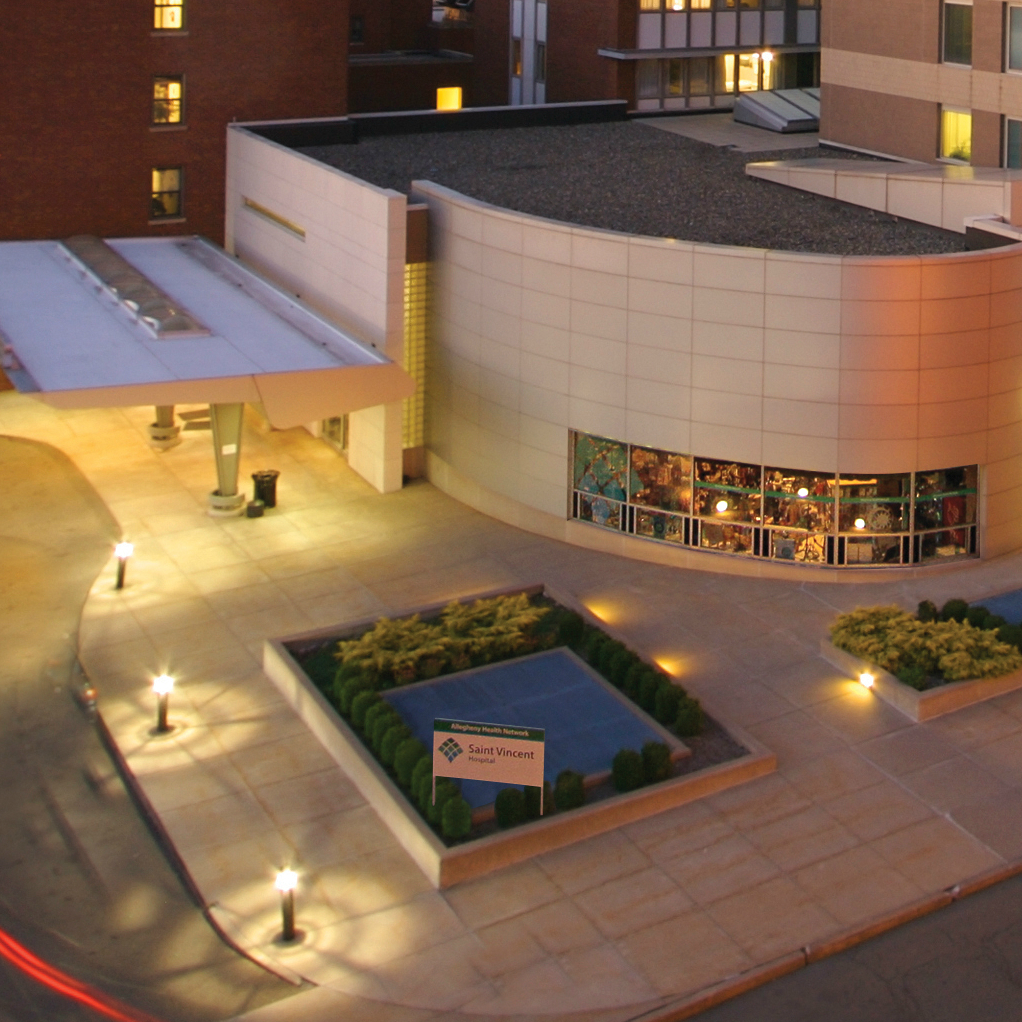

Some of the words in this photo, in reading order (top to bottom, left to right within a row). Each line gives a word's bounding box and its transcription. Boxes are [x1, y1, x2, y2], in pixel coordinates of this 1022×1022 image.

[452, 723, 481, 732] Allegheny
[482, 726, 502, 734] Health
[504, 728, 528, 736] Network
[469, 744, 494, 755] Saint
[496, 747, 534, 759] Vincent
[469, 756, 495, 764] Hospital
